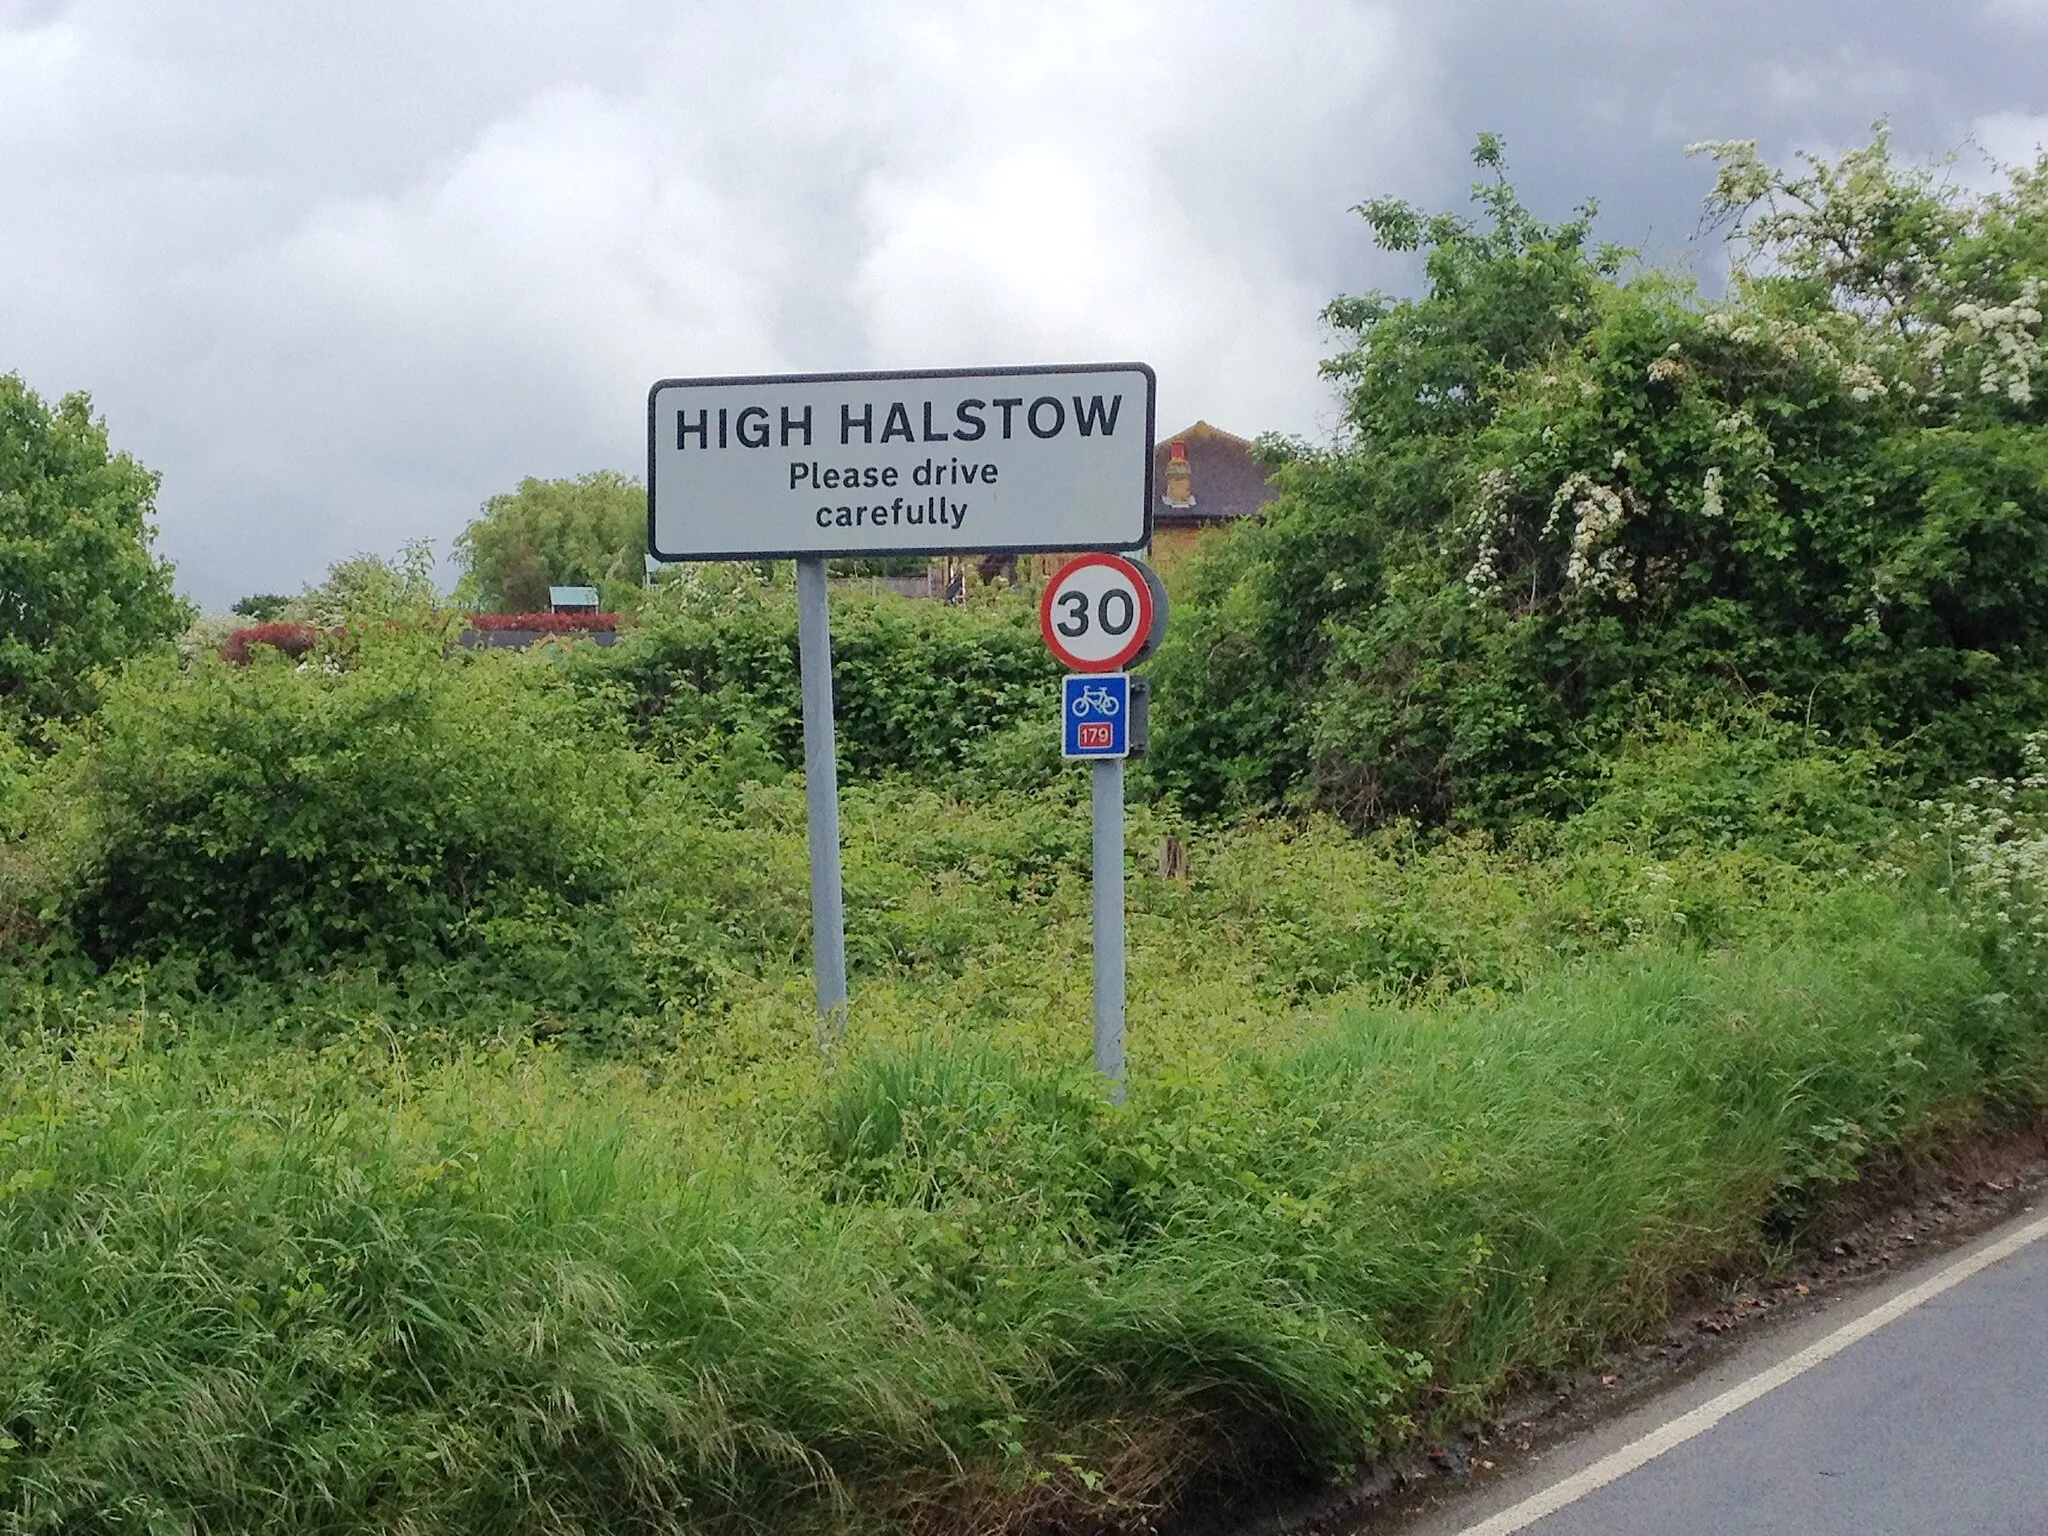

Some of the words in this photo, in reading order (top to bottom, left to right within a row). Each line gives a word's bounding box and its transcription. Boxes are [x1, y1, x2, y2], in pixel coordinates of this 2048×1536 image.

[676, 405, 813, 450] HIGH
[840, 394, 1123, 445] HALSTOW
[789, 462, 899, 490] Please
[913, 457, 999, 487] drive
[815, 495, 968, 529] carefully
[1057, 588, 1134, 638] 30
[1081, 728, 1110, 744] 179
